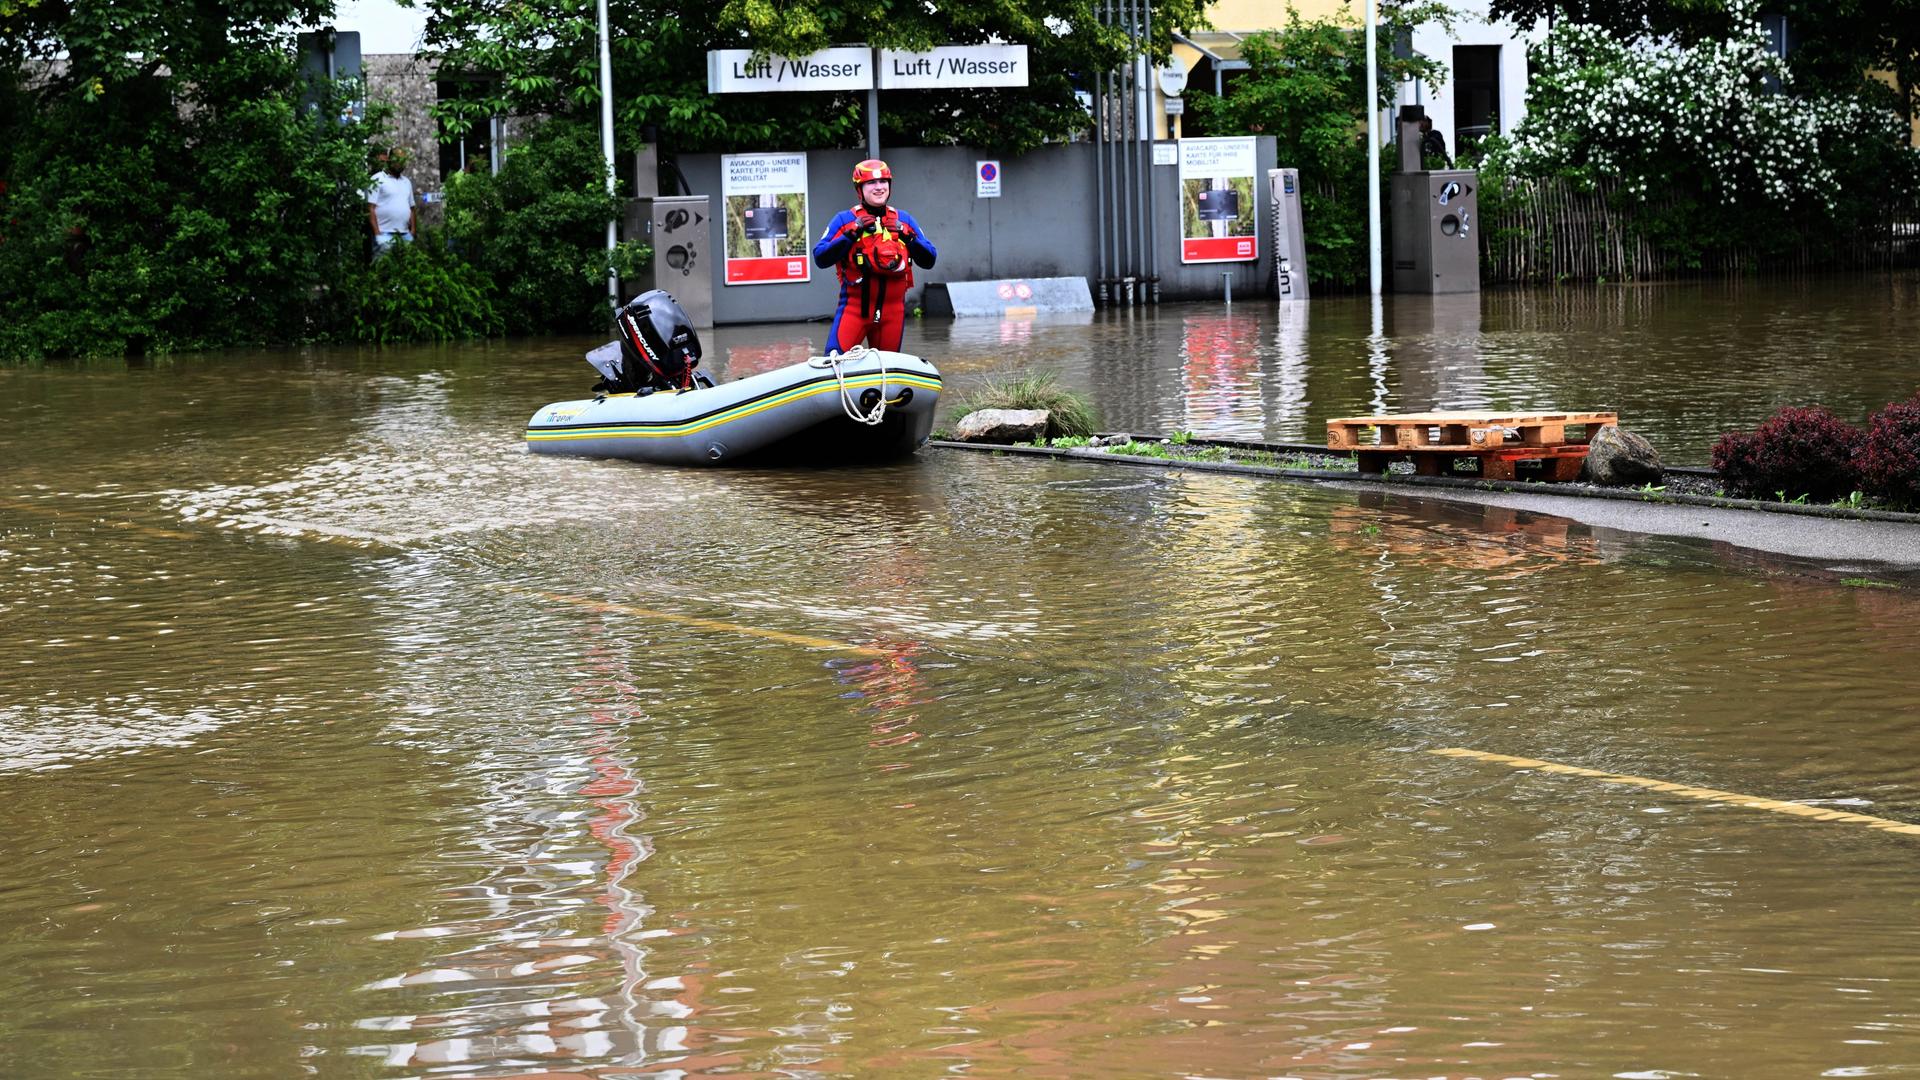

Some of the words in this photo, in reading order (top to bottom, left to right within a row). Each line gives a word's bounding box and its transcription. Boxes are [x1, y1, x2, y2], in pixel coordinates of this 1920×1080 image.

[733, 62, 772, 79] Luft
[790, 60, 861, 78] Wasser
[893, 59, 931, 76] Luft
[948, 57, 1017, 75] Wasser
[730, 159, 766, 167] AVIACARD
[772, 158, 801, 166] UNSERE
[1279, 255, 1291, 295] LUFT
